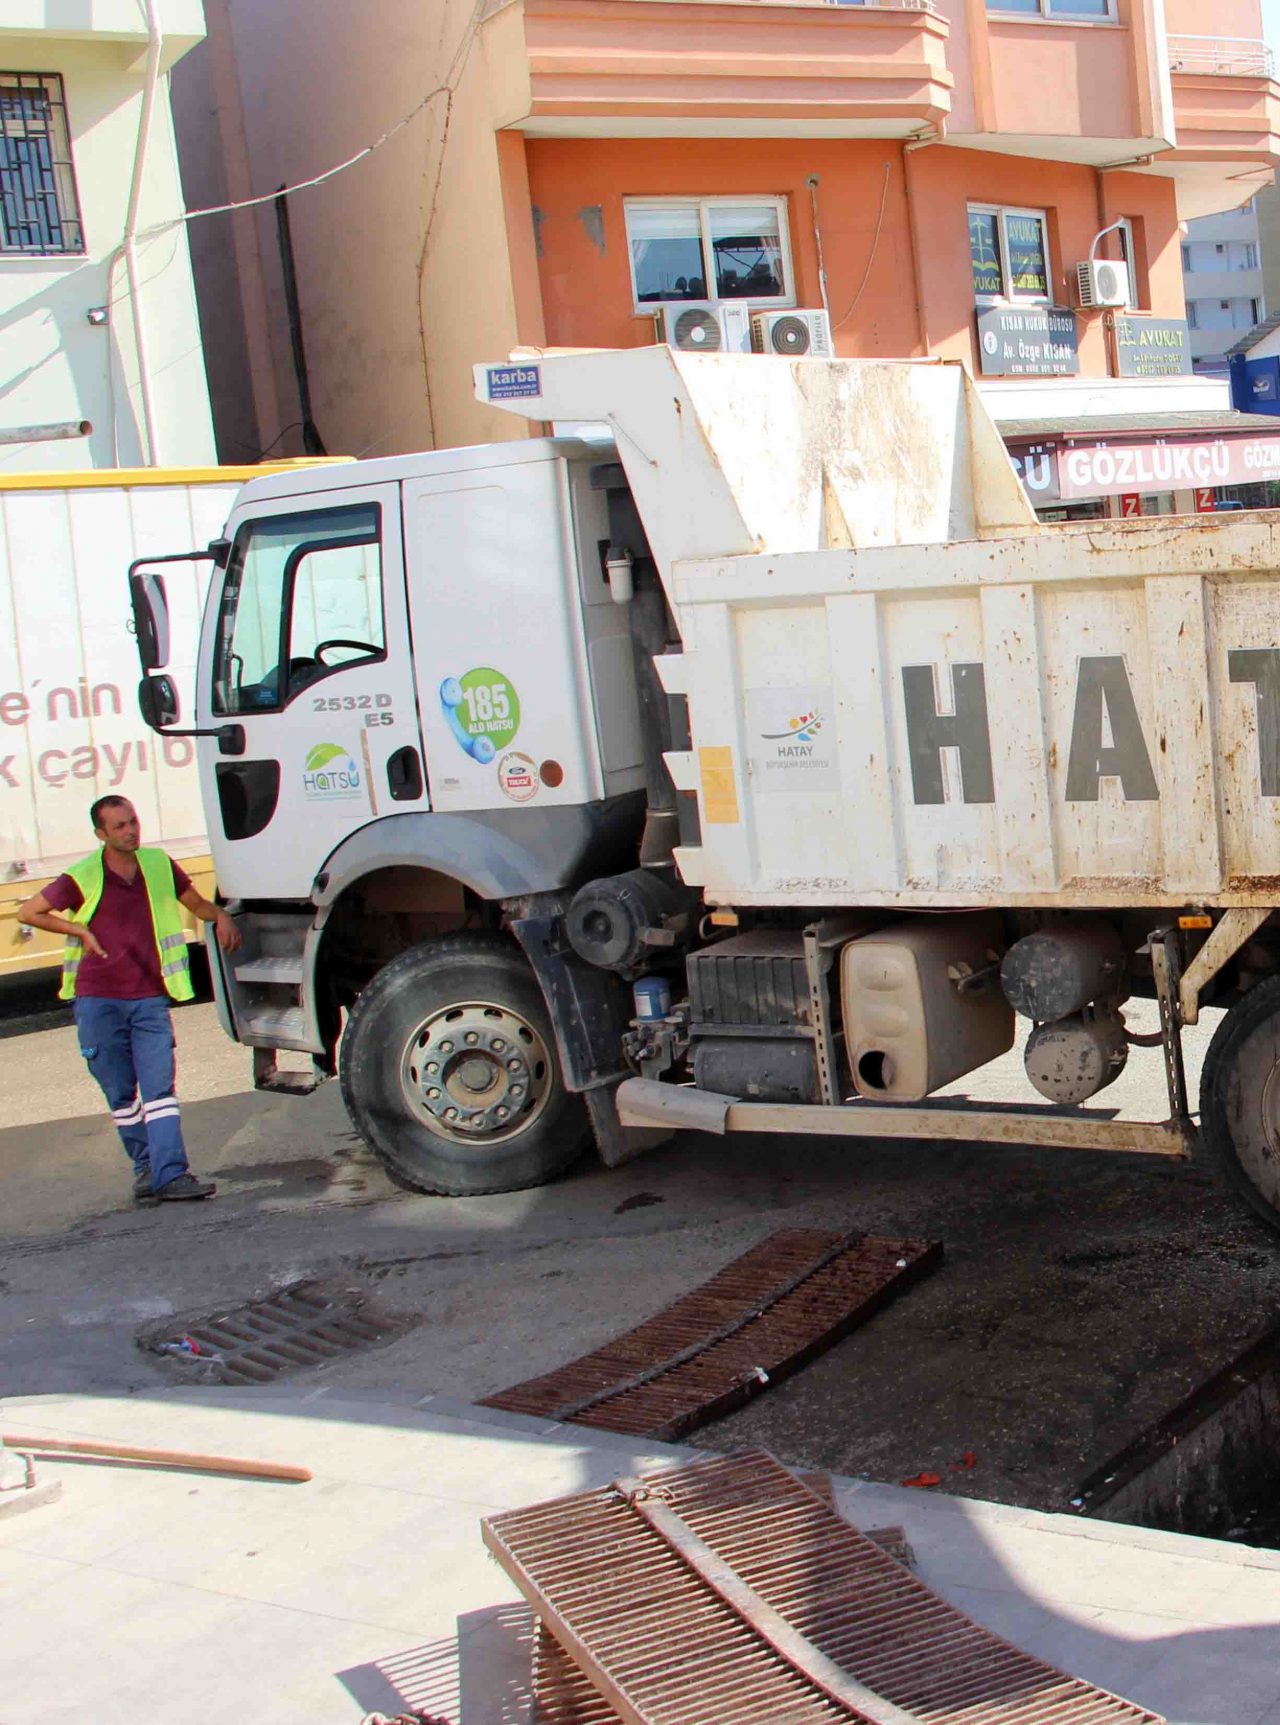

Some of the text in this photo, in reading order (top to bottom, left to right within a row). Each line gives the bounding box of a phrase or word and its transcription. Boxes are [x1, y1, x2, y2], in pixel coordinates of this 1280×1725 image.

[1000, 315, 1023, 331] KISAN
[1049, 315, 1073, 332] BÜROSU
[1140, 329, 1184, 347] AVUKAT
[1003, 338, 1072, 362] Av. Özge KISAN
[491, 369, 537, 385] karba
[1067, 438, 1231, 486] GÖZLÜKÇÜ
[313, 693, 392, 713] 2532 D
[463, 684, 510, 723] 185
[364, 711, 394, 728] E5
[468, 724, 486, 734] ALO
[777, 746, 813, 757] HATAY
[38, 740, 149, 788] çayı
